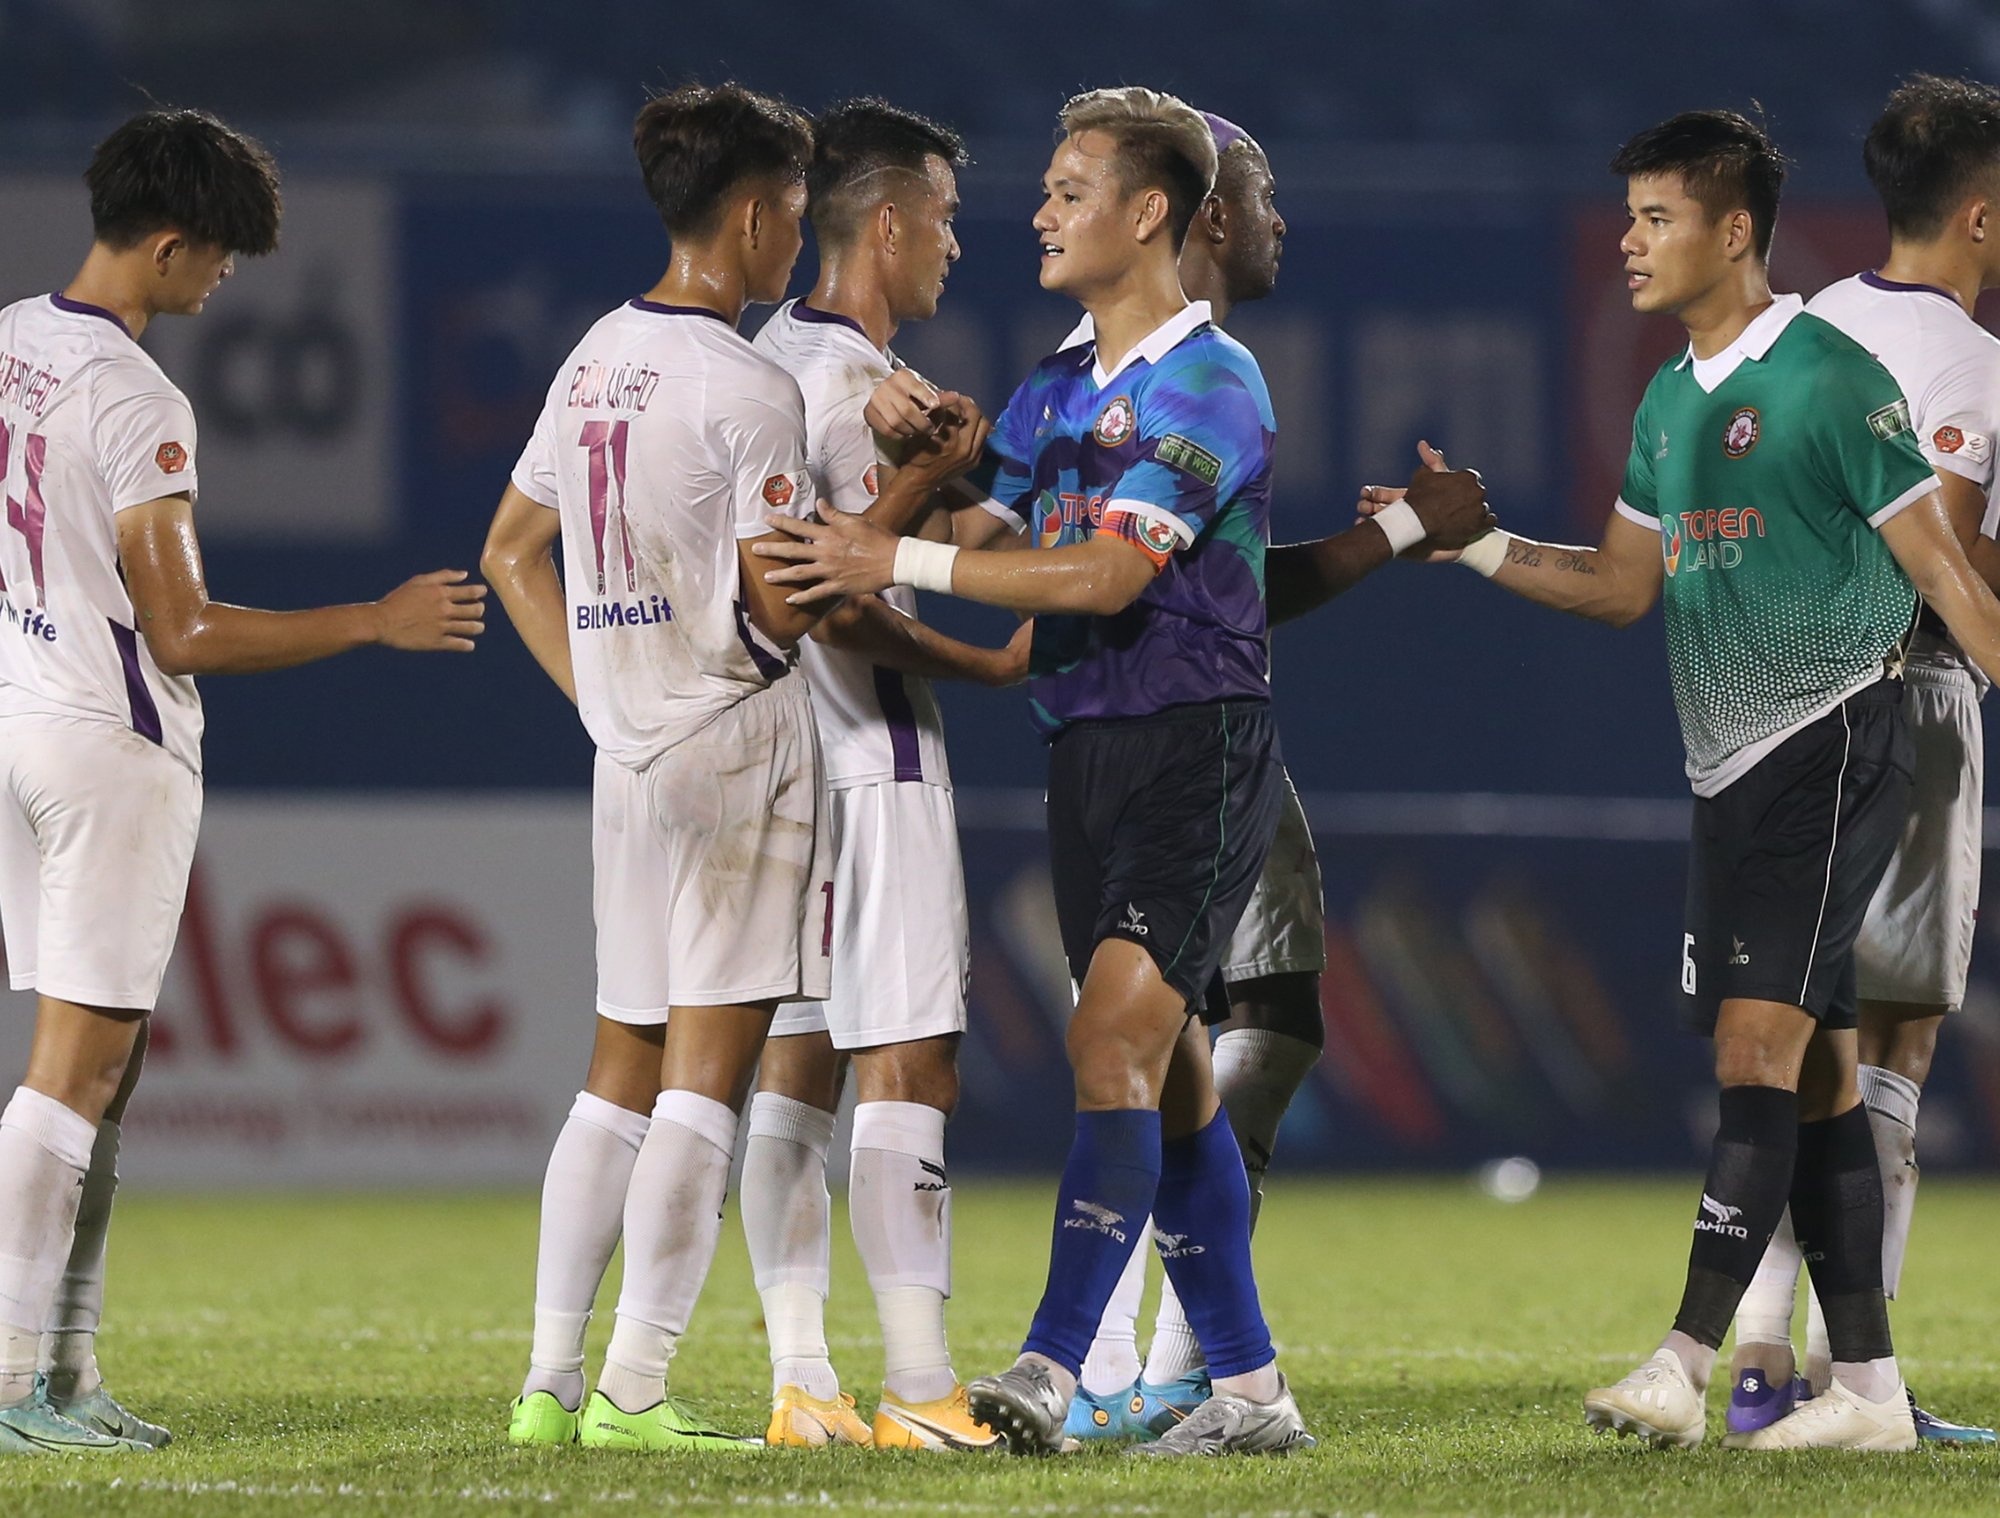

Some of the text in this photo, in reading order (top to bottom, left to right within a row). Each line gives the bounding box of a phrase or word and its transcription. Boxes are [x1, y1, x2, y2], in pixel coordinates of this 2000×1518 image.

[1192, 454, 1218, 478] WOLF
[577, 420, 636, 596] 11
[1679, 507, 1765, 541] TOPEN
[1685, 541, 1743, 572] LAND
